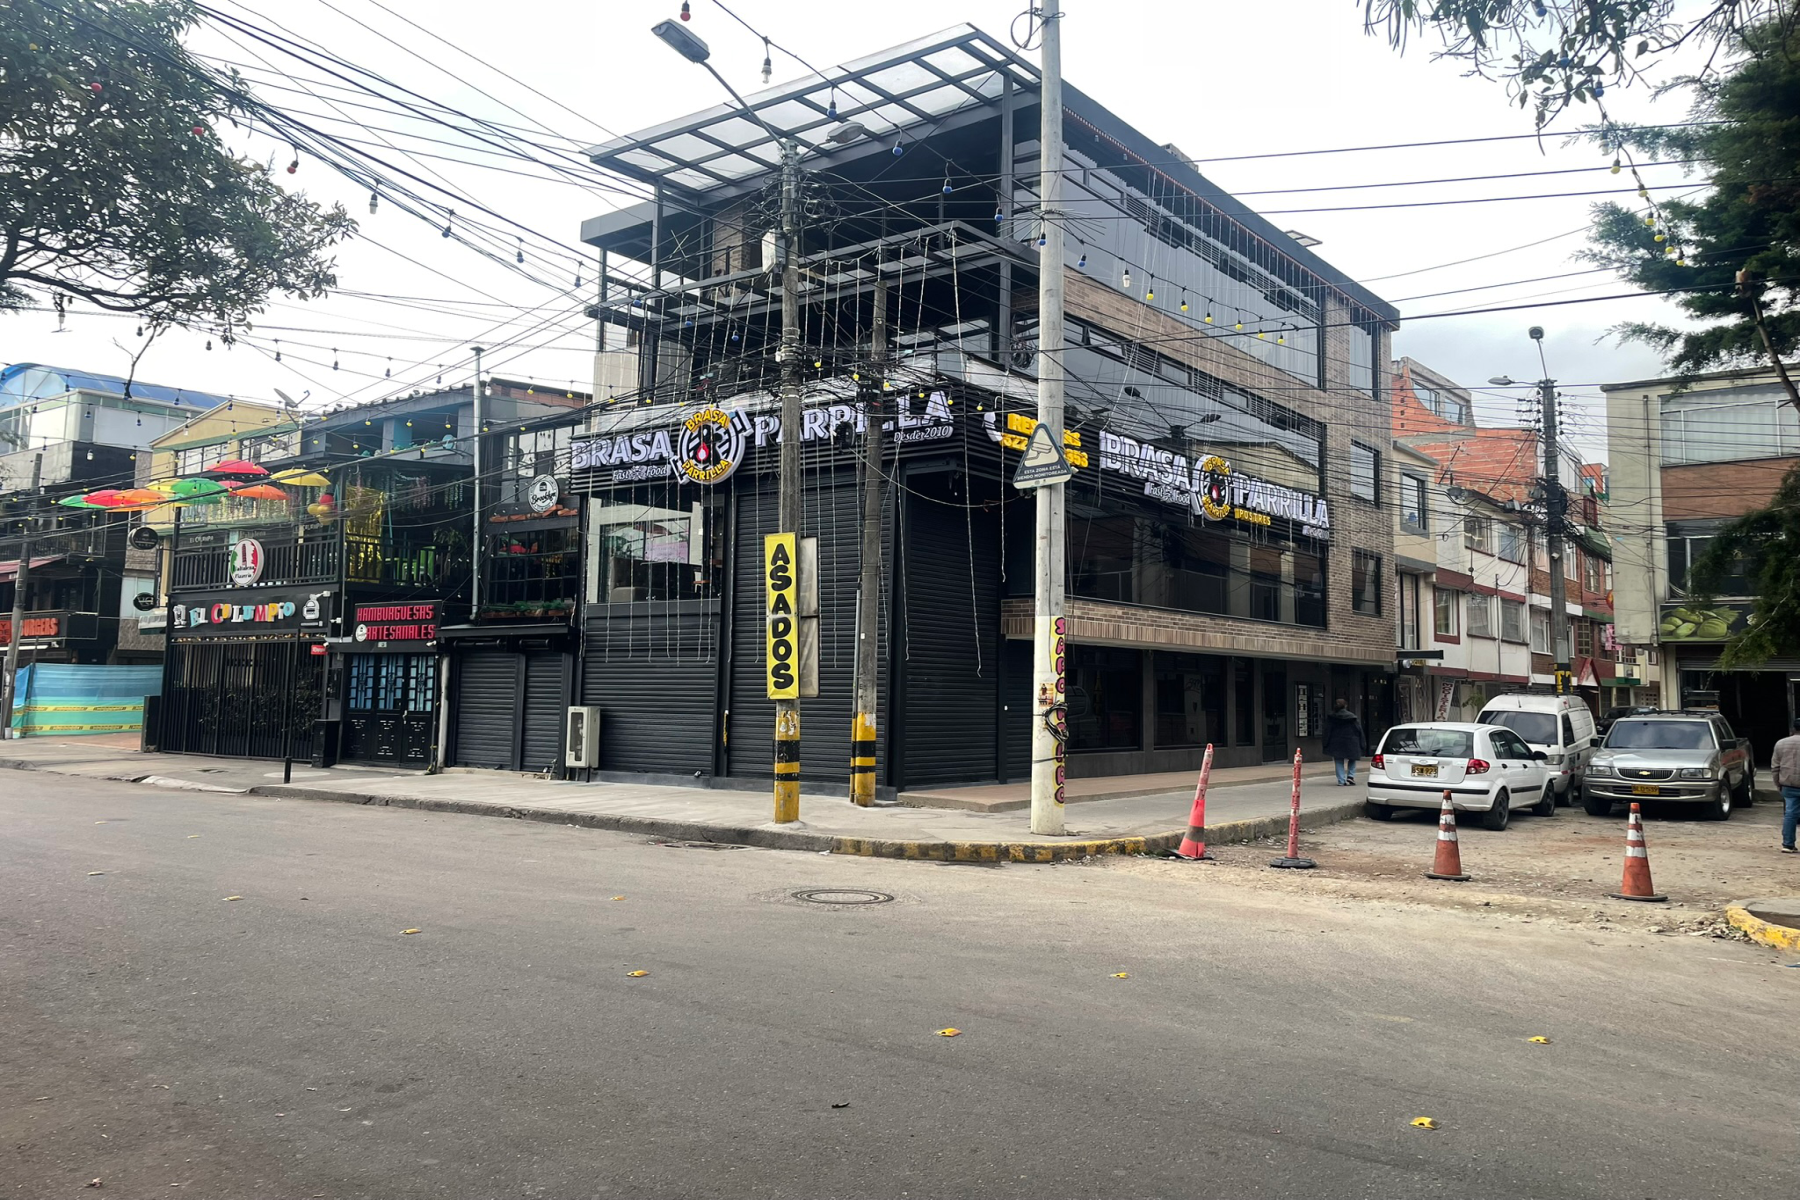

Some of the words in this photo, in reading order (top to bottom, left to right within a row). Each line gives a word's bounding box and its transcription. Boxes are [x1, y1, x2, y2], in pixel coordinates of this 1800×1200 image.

[685, 408, 731, 433] BRASA
[924, 426, 951, 440] 2010
[571, 430, 675, 470] BRASA
[612, 470, 633, 482] Fast
[647, 466, 669, 477] Food
[682, 457, 734, 481] PARRILLA
[1099, 431, 1191, 490] BRASA
[1233, 472, 1330, 529] PARRILLA
[1235, 508, 1271, 525] POSTRES
[356, 605, 434, 621] HAMBURGUESAS
[769, 542, 795, 690] ASADOS
[366, 625, 437, 640] ARTESANALES
